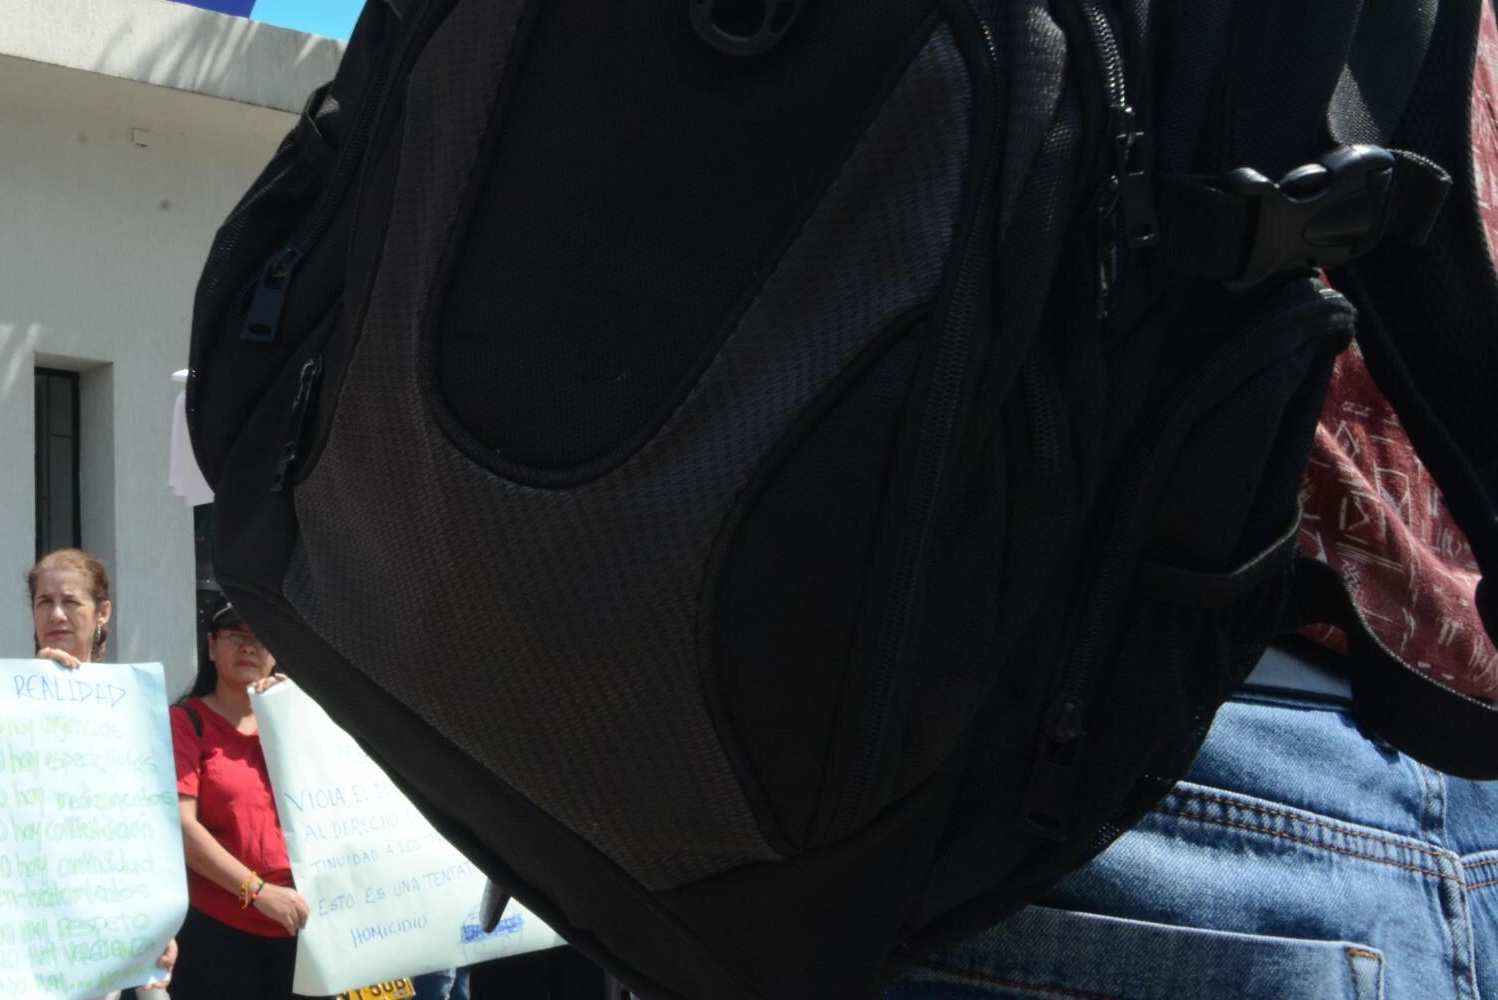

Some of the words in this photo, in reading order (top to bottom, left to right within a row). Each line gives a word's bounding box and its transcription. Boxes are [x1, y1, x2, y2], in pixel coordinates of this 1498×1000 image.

[13, 674, 127, 708] REALIDAD
[284, 787, 346, 812] VIOLA
[393, 877, 420, 898] UNA
[350, 915, 429, 949] HOMICIDIO
